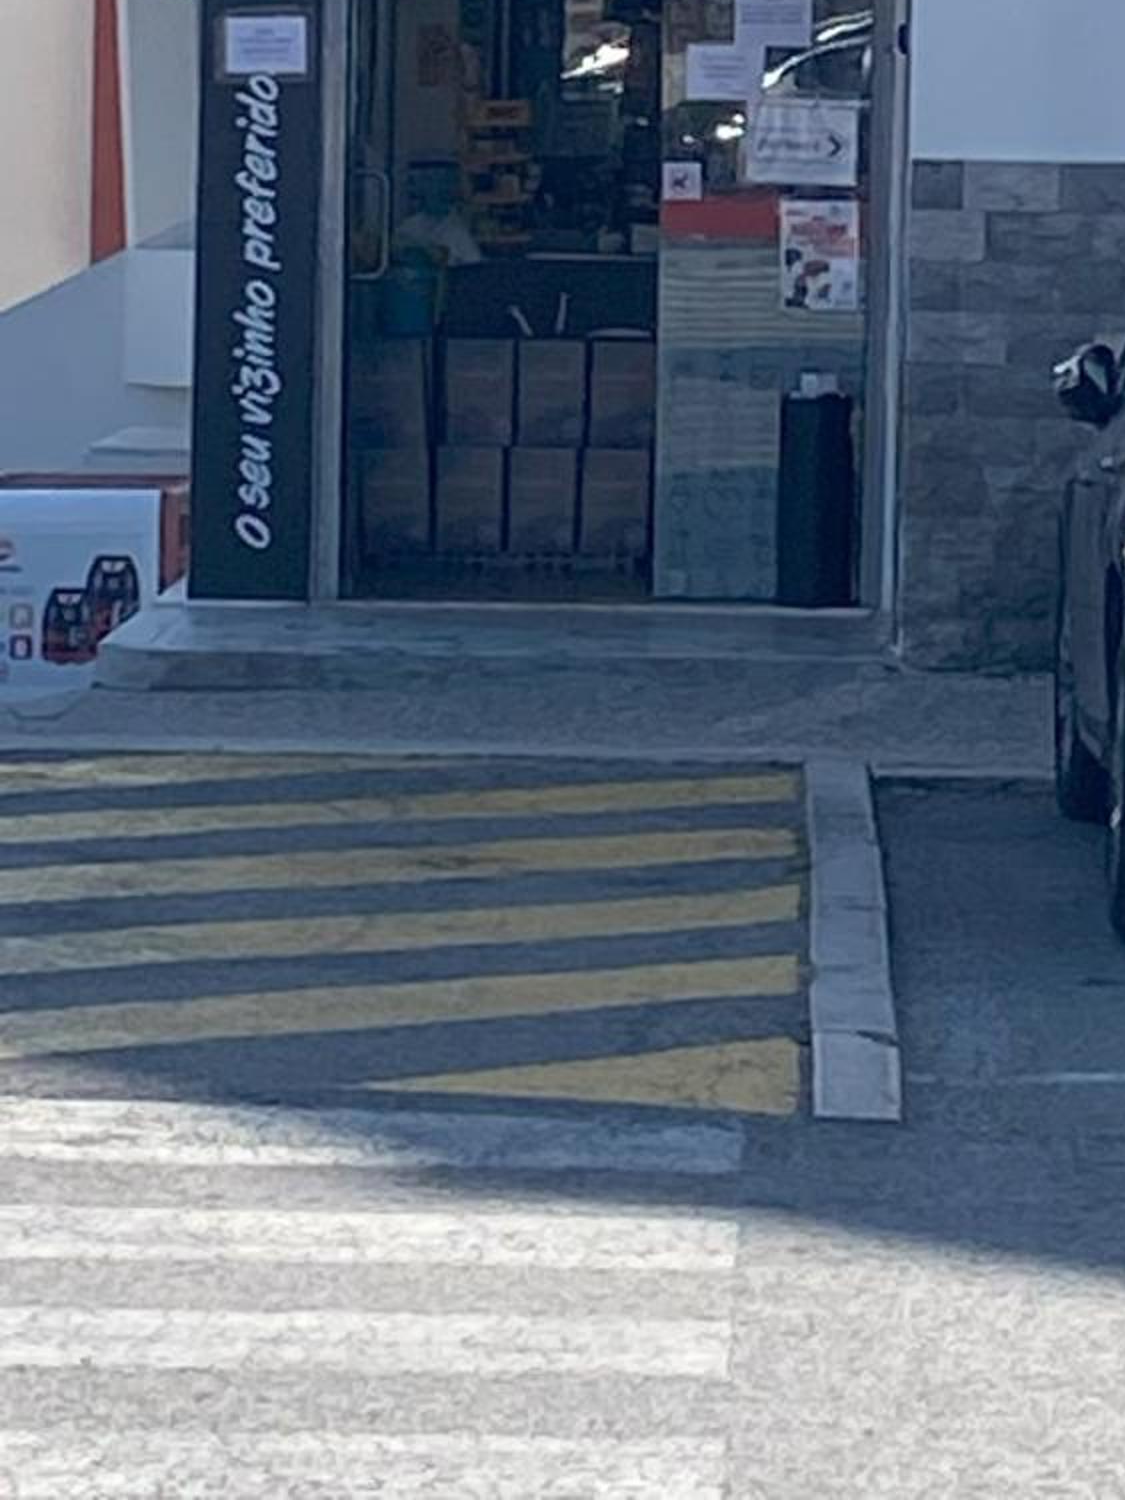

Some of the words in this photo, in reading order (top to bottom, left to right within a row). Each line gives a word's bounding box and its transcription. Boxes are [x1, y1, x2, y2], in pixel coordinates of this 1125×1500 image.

[235, 74, 283, 270] preferido
[232, 281, 281, 425] vizinho
[238, 434, 272, 510] seu
[235, 514, 271, 548] O
